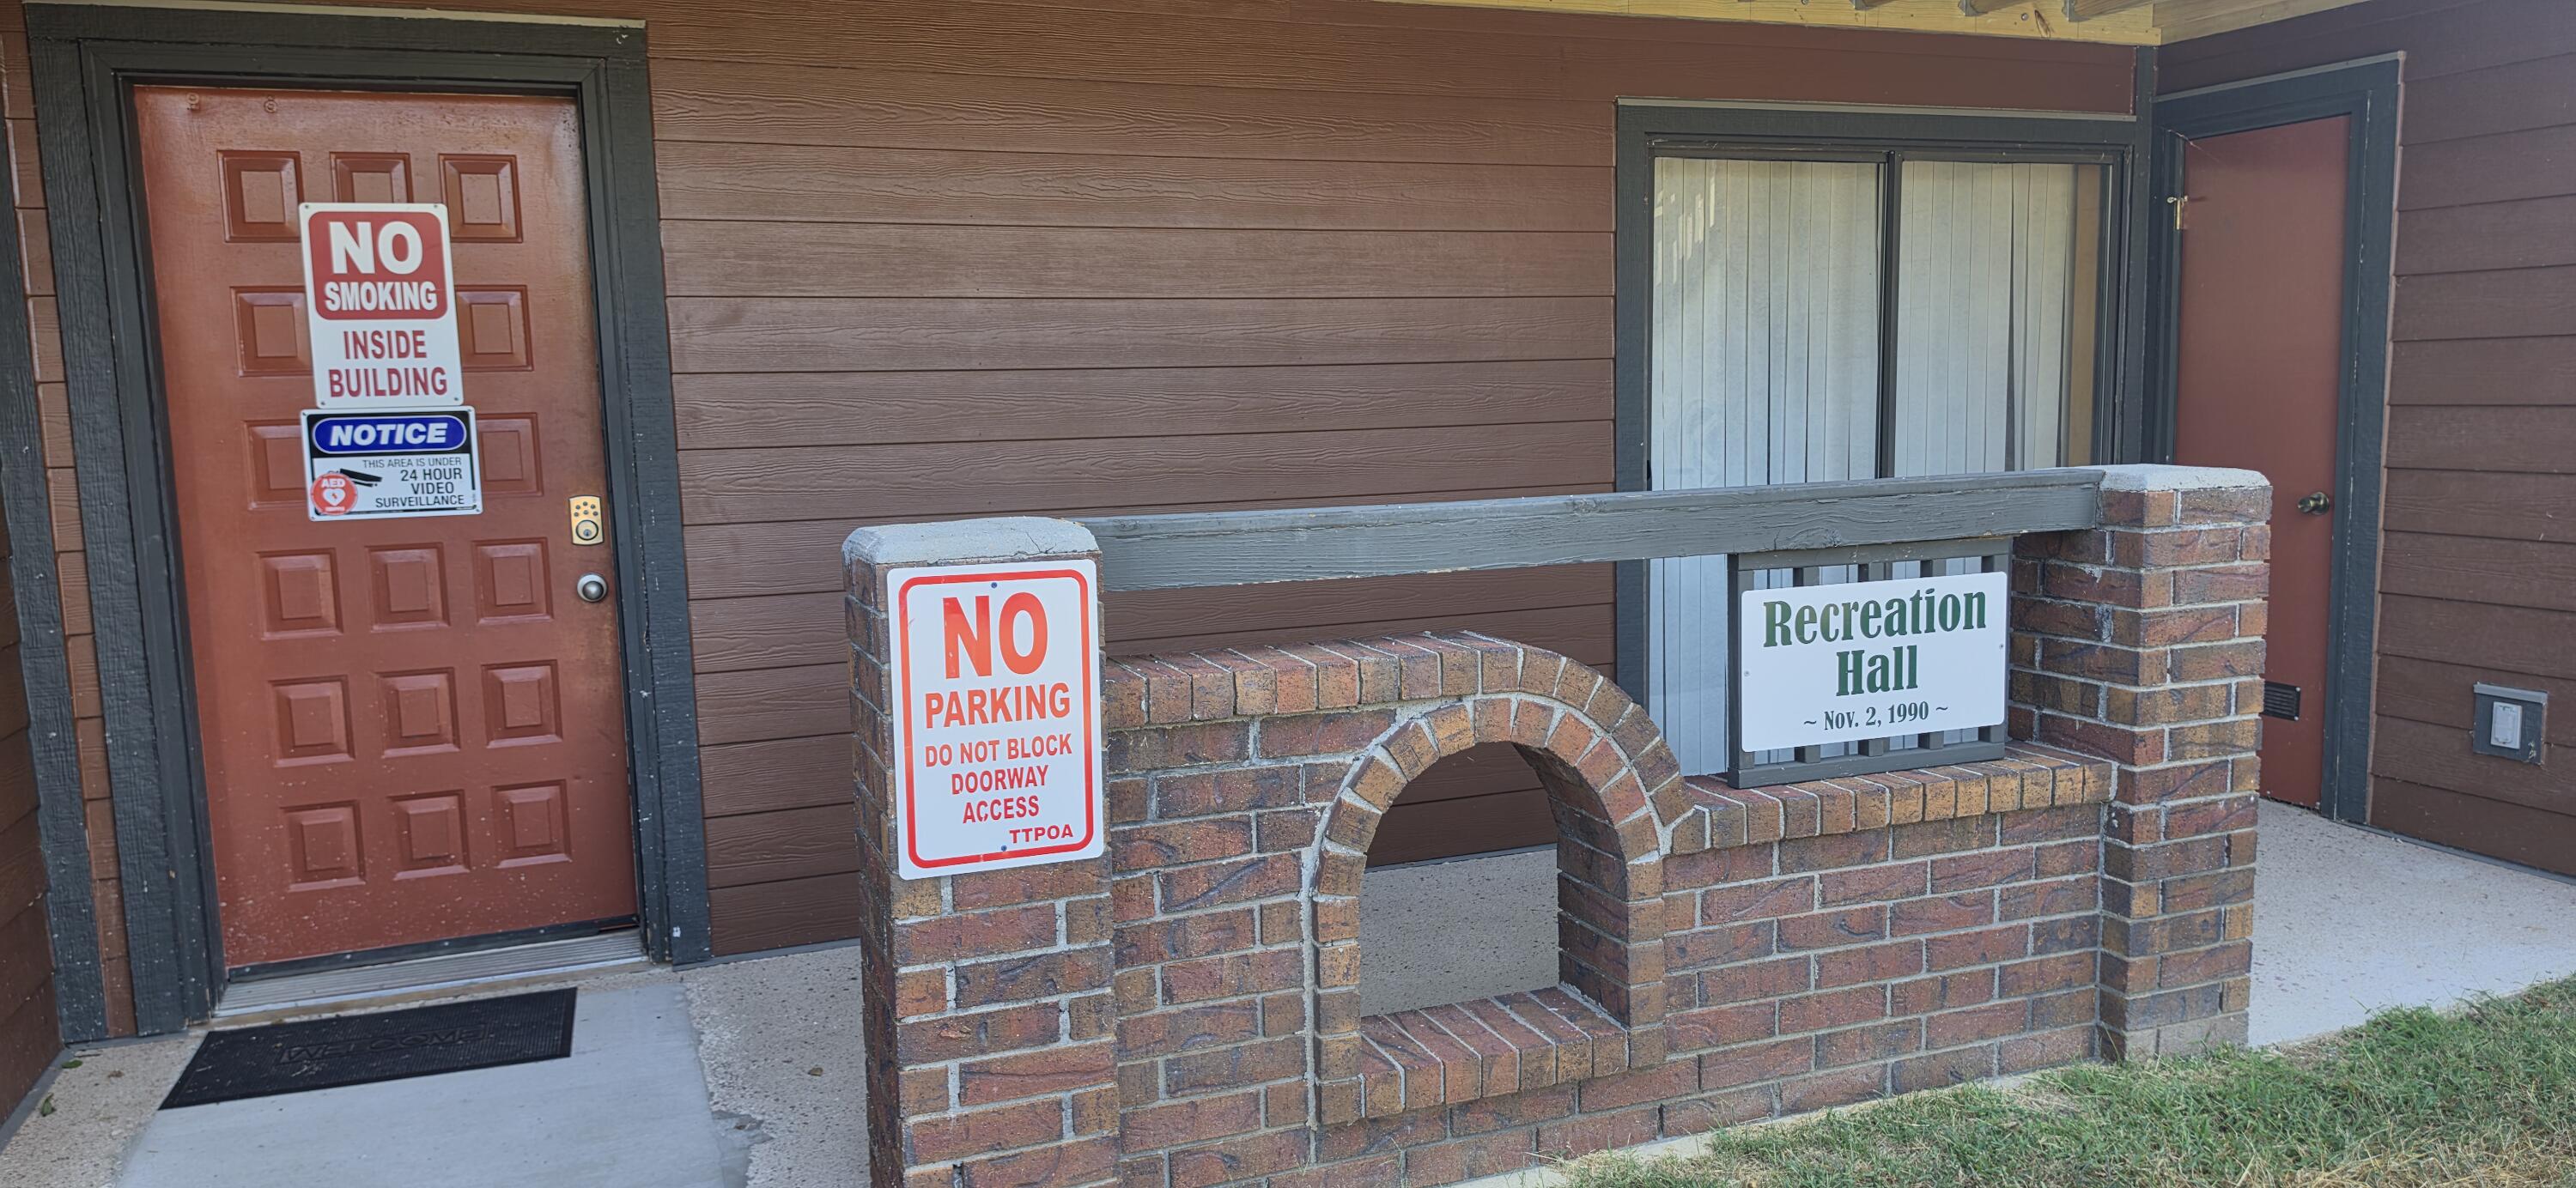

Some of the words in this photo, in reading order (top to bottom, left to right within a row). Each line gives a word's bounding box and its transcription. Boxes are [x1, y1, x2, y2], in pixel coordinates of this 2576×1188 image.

[328, 221, 423, 275] NO
[325, 281, 438, 311] SMOKING
[343, 330, 427, 360] INSIDE
[328, 367, 447, 397] BUILDING
[330, 422, 449, 446] NOTICE
[362, 459, 386, 469] THIS
[387, 458, 414, 468] AREA
[416, 458, 426, 467] IS
[428, 457, 463, 466] UNDER
[400, 470, 418, 482] 24
[422, 468, 463, 481] HOUR
[321, 478, 346, 488] AED
[410, 482, 454, 495] VIDEO
[375, 495, 465, 508] SURVEILLANCE
[1762, 588, 1986, 647] Recreation
[942, 591, 1048, 680] NO
[1836, 645, 1918, 696] Hall
[925, 682, 1071, 729] PARKING
[1824, 711, 1859, 730] Nov.
[1865, 706, 1882, 727] 2,
[1888, 701, 1929, 724] 1990
[925, 745, 953, 767] DO
[960, 740, 1000, 764] NOT
[1007, 733, 1072, 761] BLOCK
[951, 765, 1048, 795] DOORWAY
[963, 795, 1040, 824] ACCESS
[1009, 824, 1073, 844] TTPOA
